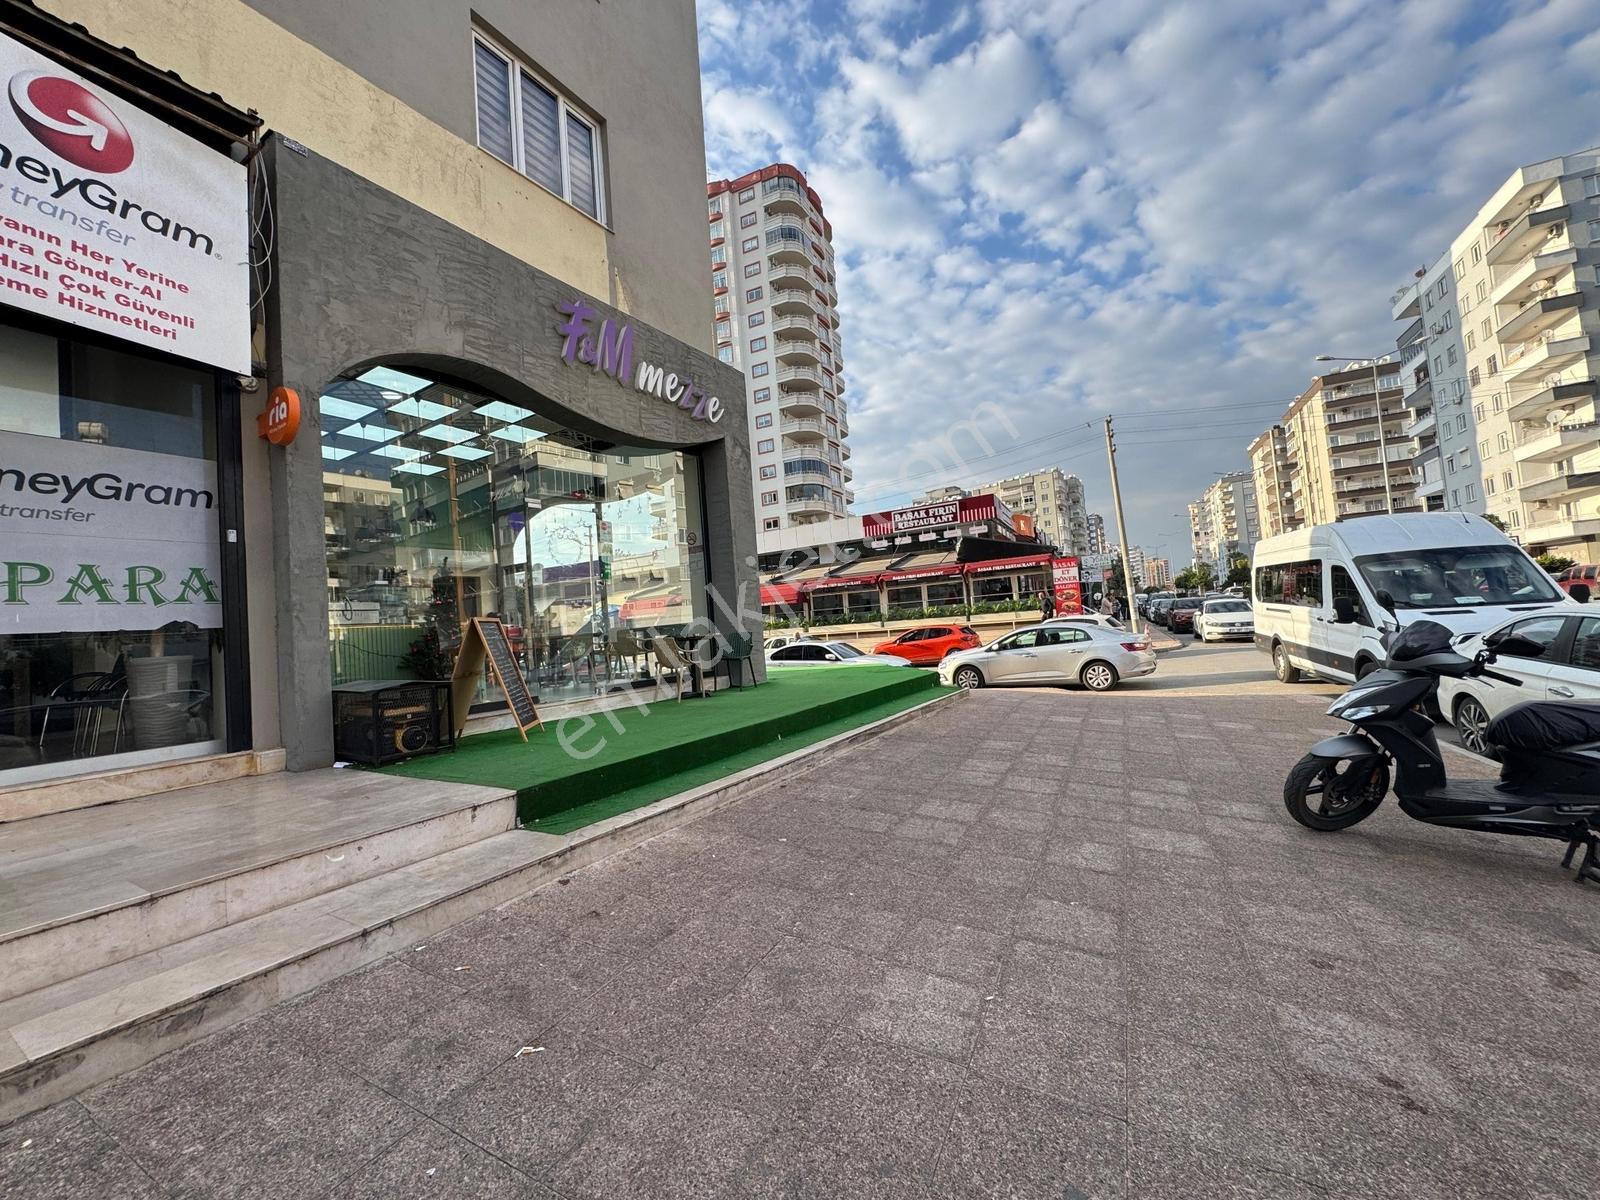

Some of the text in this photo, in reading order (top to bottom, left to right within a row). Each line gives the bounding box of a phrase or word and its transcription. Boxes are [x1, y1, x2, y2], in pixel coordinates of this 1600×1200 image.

[11, 187, 136, 246] transfer
[0, 215, 190, 294] anın Her Yerine
[44, 249, 161, 301] Gönder-Al
[58, 291, 177, 340] Hizmetleri
[59, 273, 106, 301] Çok
[114, 293, 195, 329] Güvenli
[269, 396, 288, 426] ria
[635, 361, 725, 424] mezze
[0, 503, 96, 522] transfer
[897, 514, 954, 529] RESTAURANT
[0, 561, 221, 608] PARA
